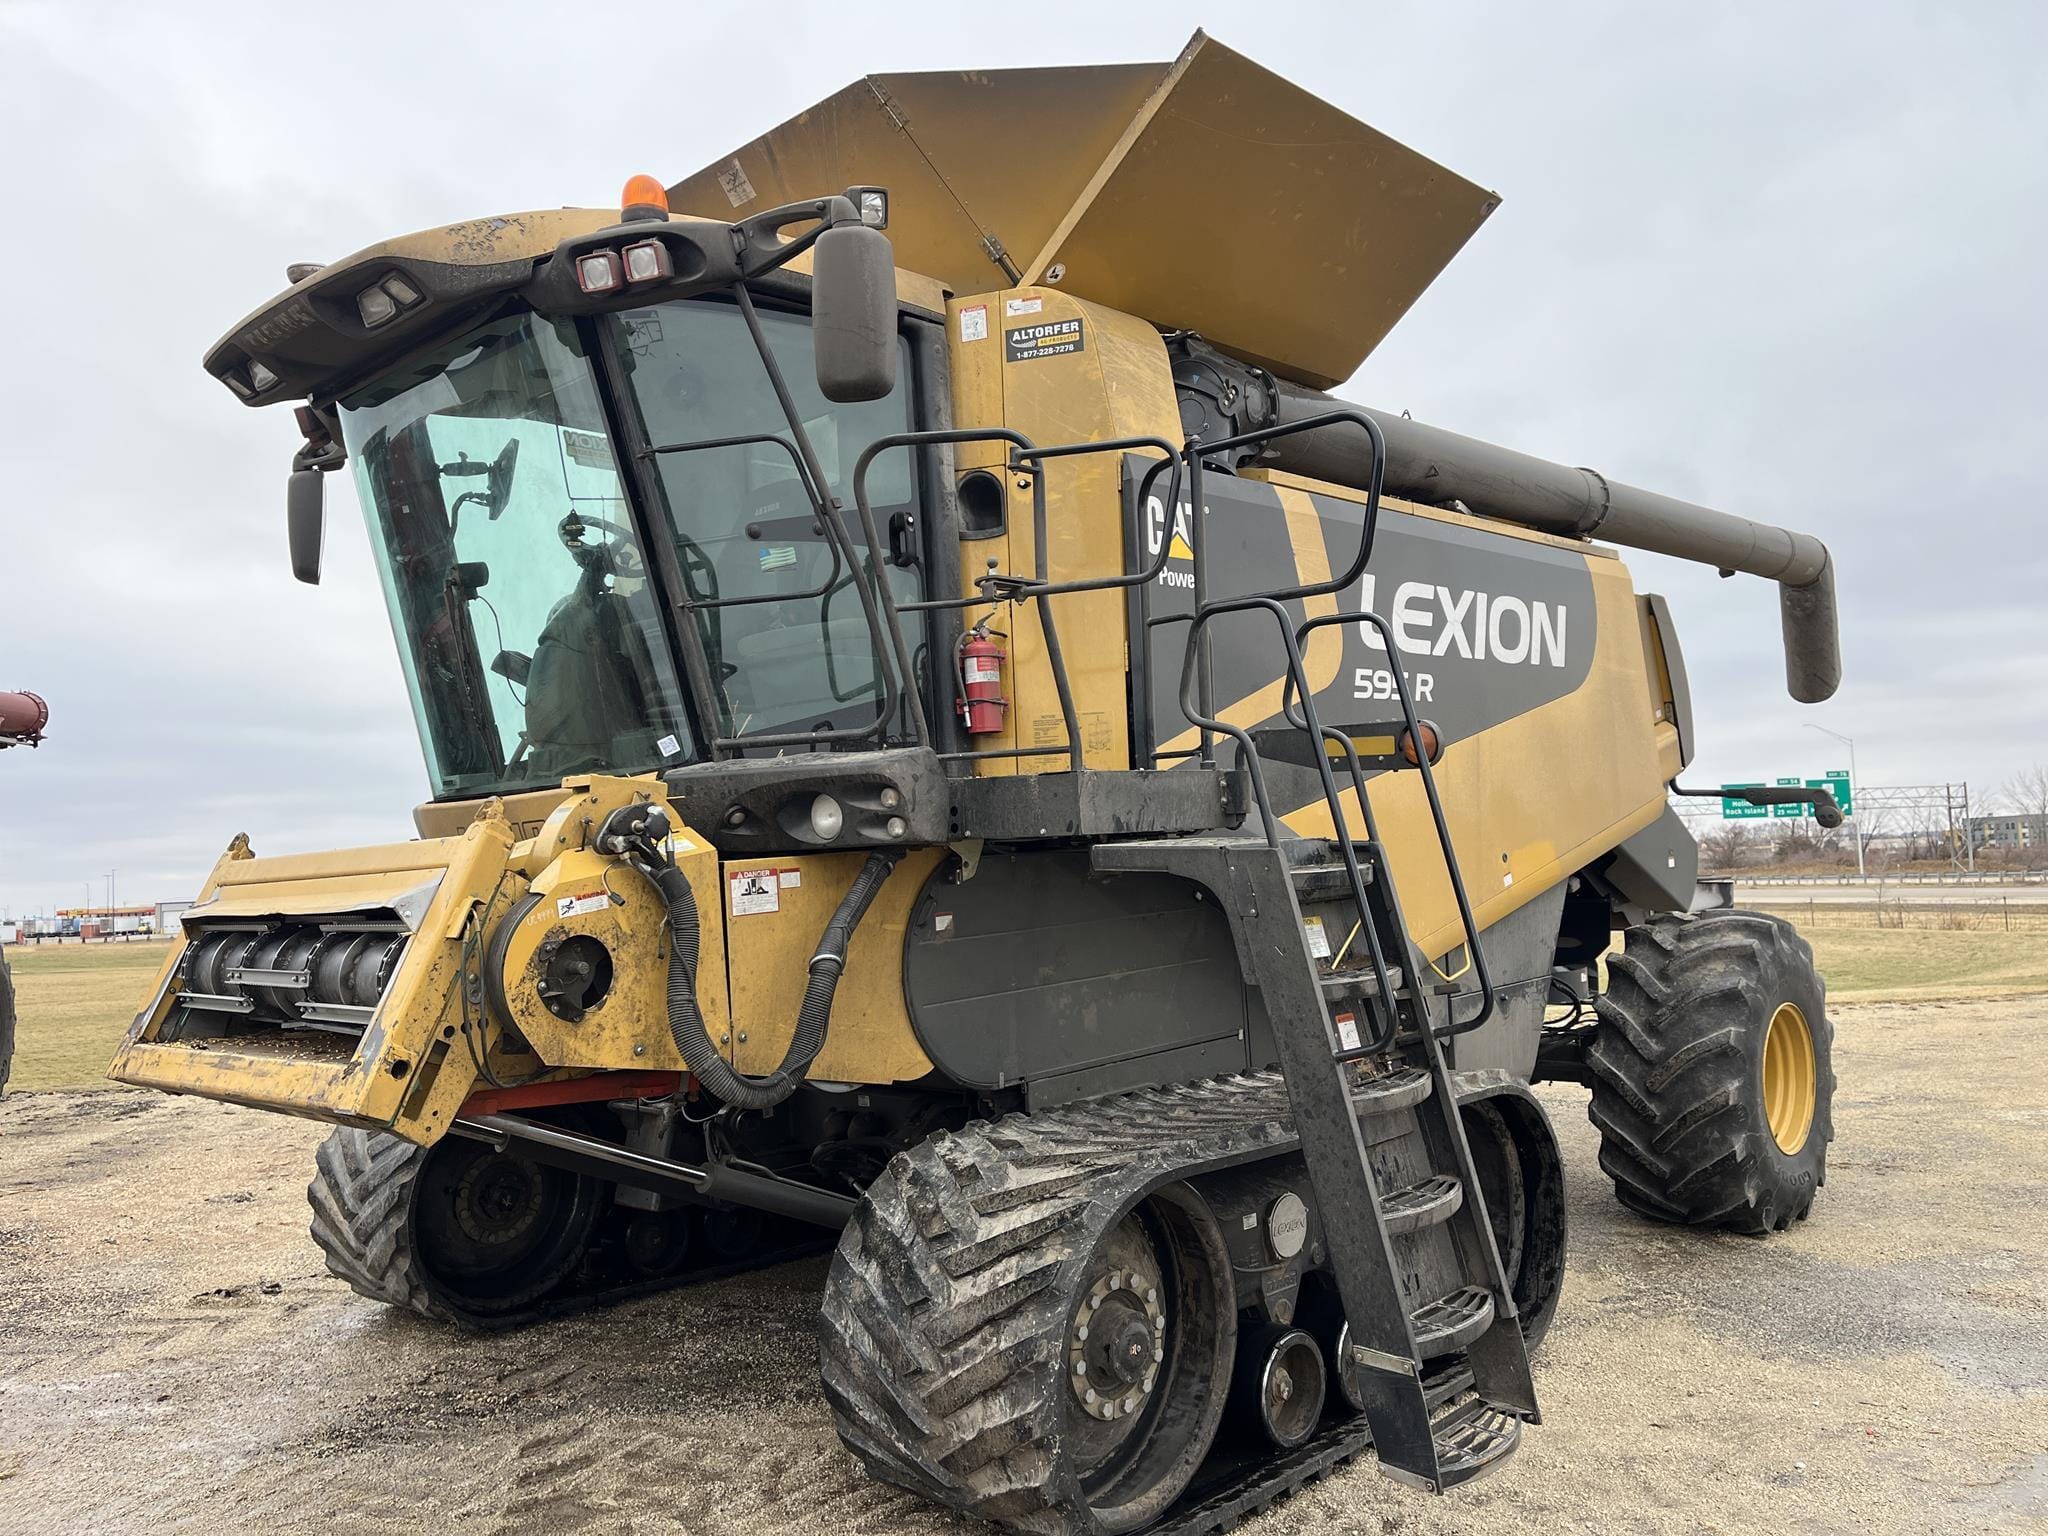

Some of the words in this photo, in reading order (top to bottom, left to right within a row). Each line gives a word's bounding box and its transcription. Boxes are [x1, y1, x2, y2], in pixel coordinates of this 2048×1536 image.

[1013, 322, 1079, 341] ALTORFER
[1017, 344, 1074, 359] 1-877-228-7278
[1159, 566, 1195, 588] Powe
[1360, 573, 1567, 667] LEXION
[1415, 673, 1434, 702] R
